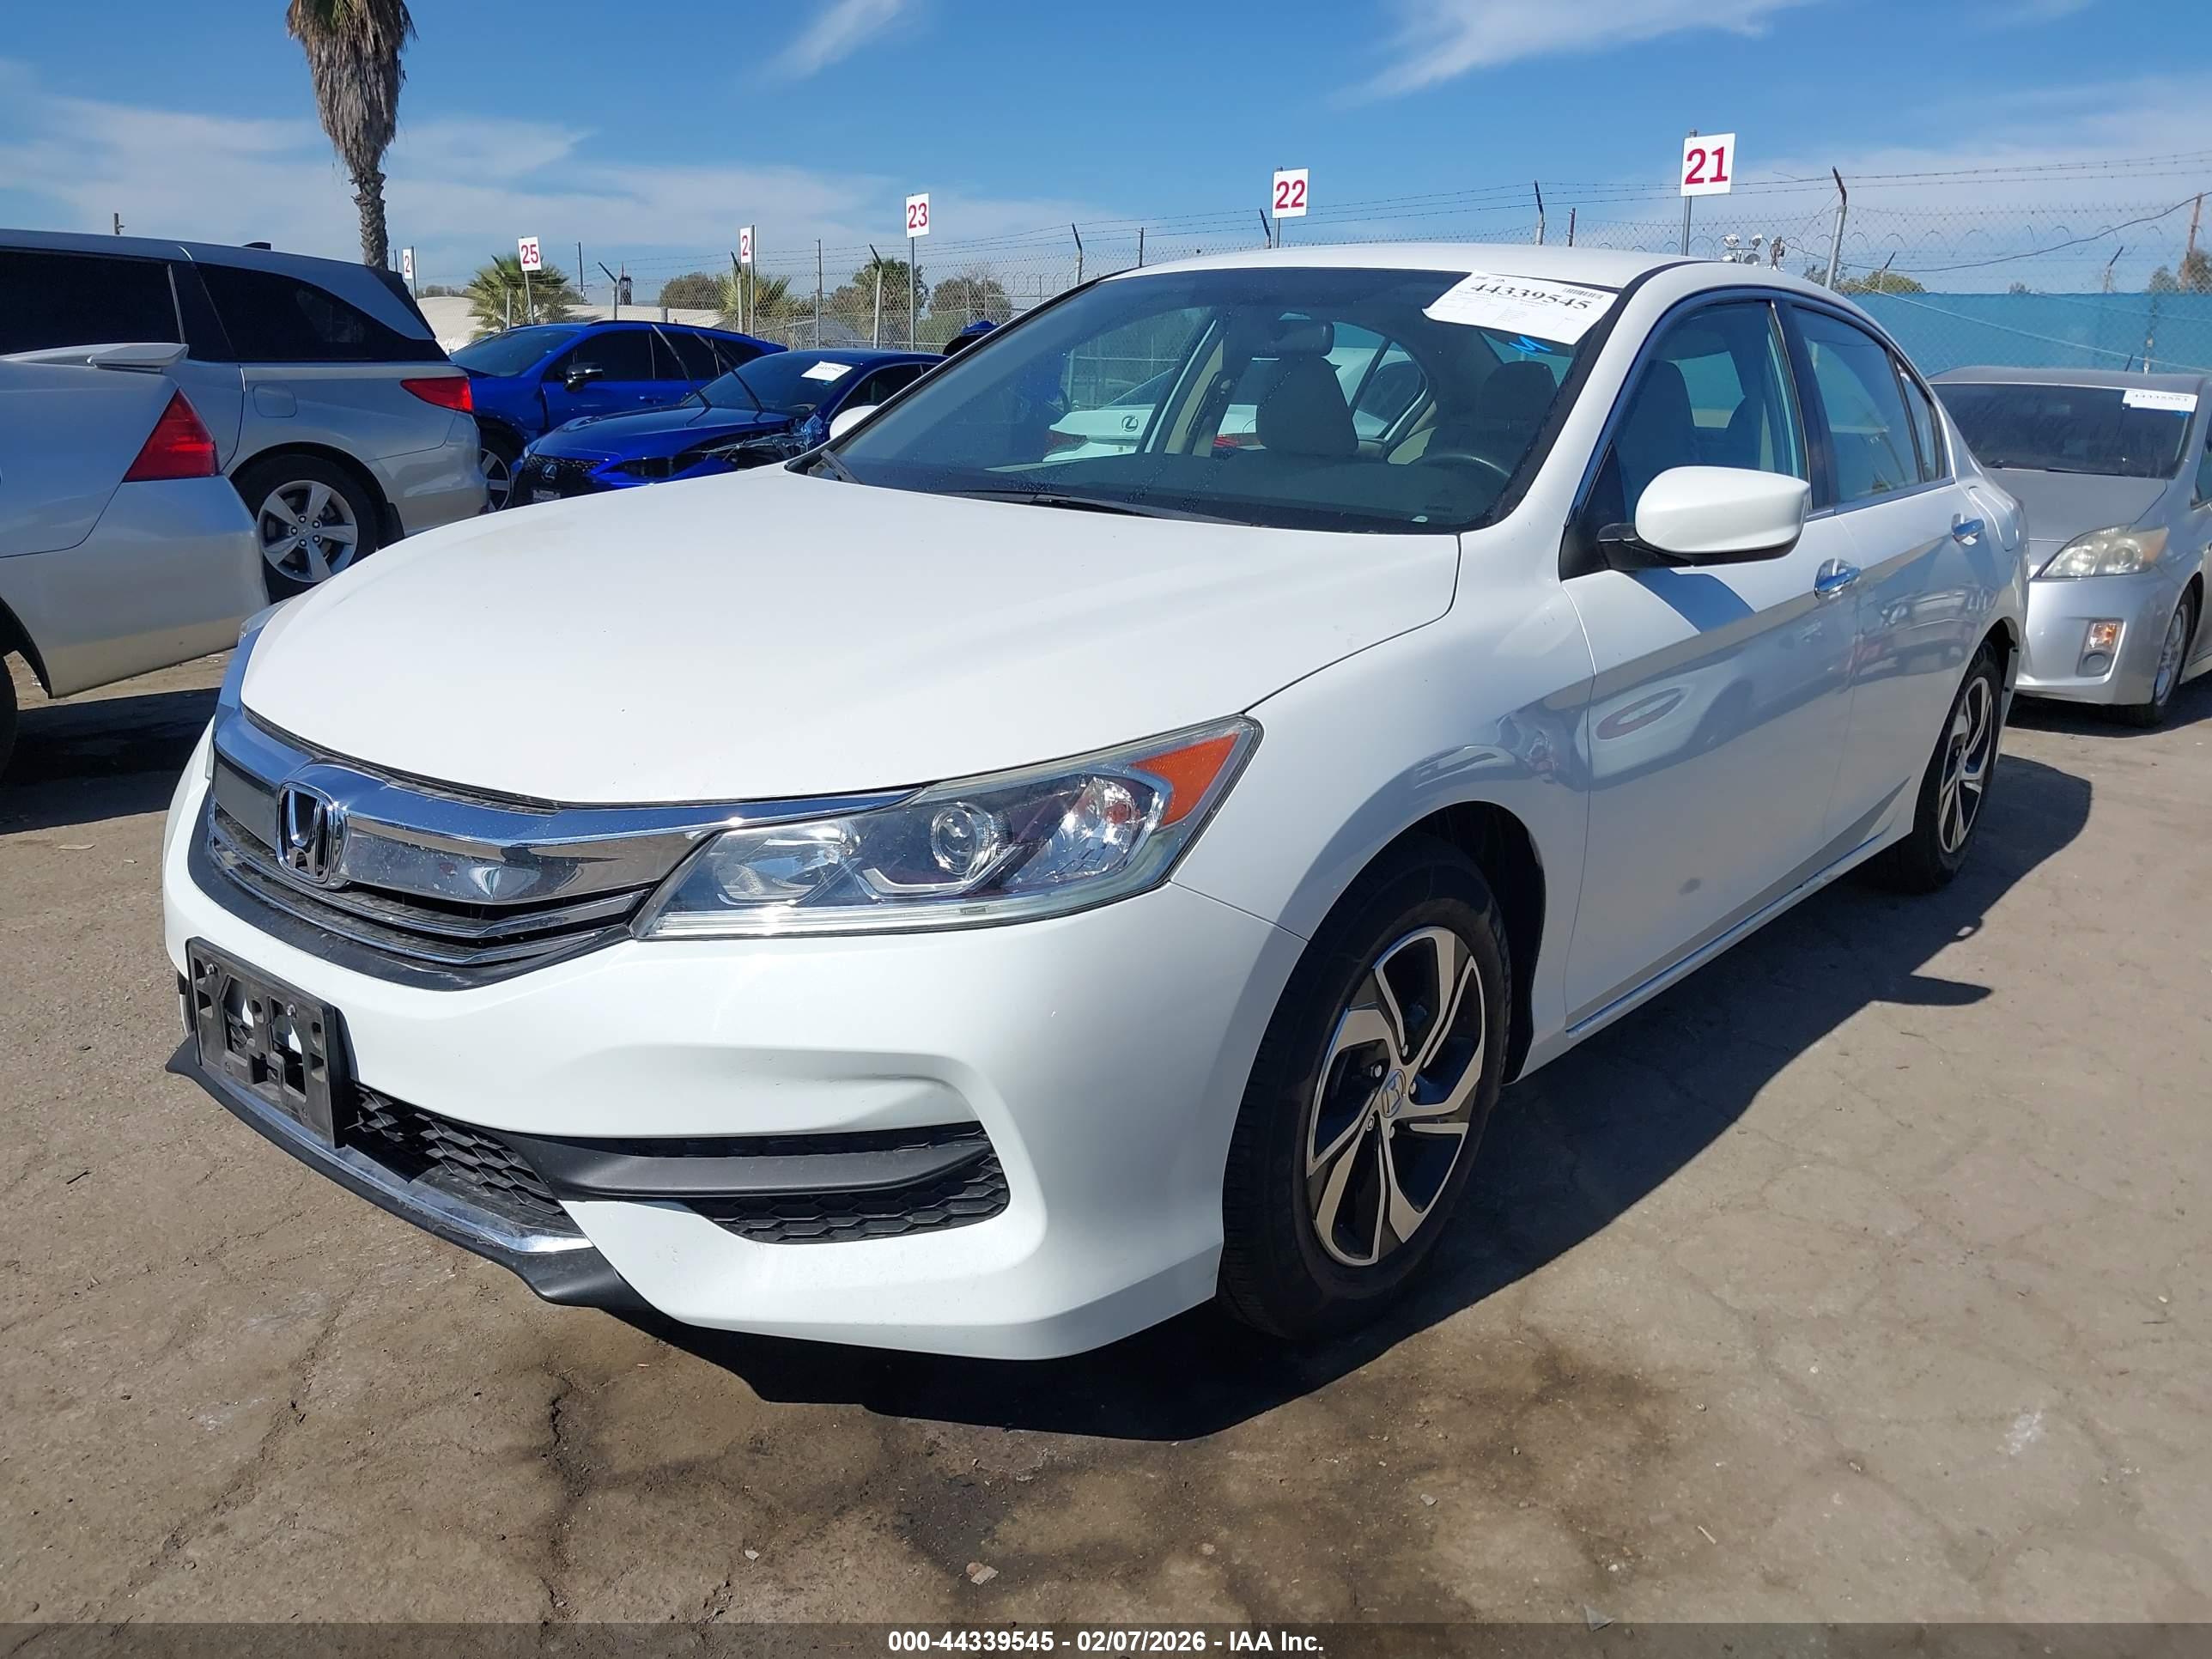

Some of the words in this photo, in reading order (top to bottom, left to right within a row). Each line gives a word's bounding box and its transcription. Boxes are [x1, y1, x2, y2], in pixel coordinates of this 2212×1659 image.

[1685, 146, 1729, 185] 21
[1275, 179, 1305, 209] 22
[908, 202, 928, 229] 23
[520, 244, 539, 264] 25
[1470, 283, 1593, 310] 44339545
